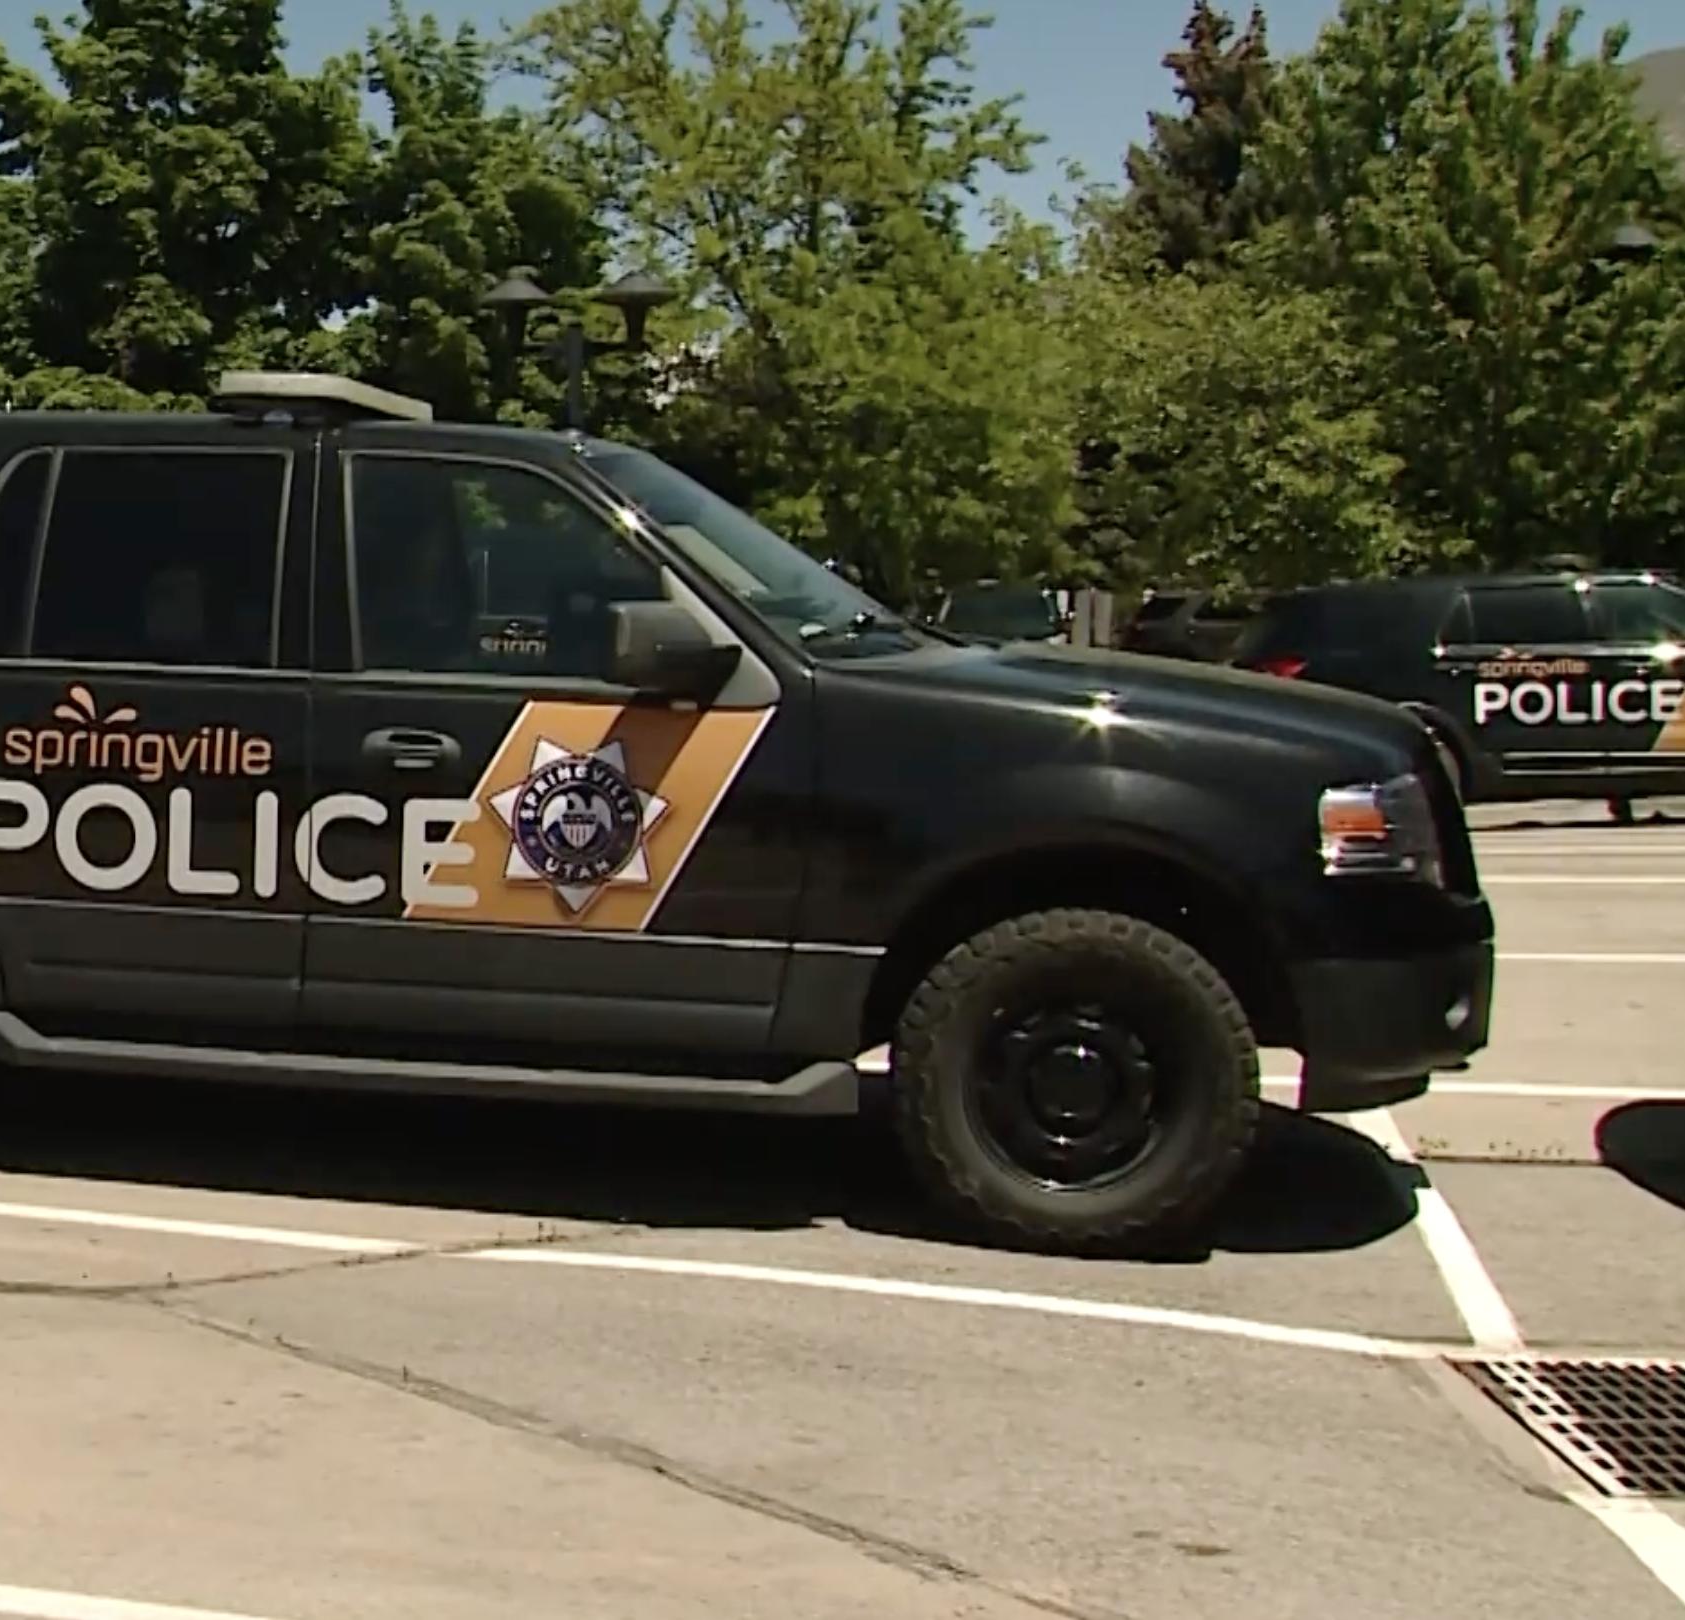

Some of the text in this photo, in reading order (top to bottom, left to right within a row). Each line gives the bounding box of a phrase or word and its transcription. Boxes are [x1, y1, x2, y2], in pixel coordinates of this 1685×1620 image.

[1473, 679, 1685, 725] POLICE
[3, 726, 274, 783] springville
[519, 764, 637, 823] SPRINGVILLE
[544, 856, 611, 880] UTAH
